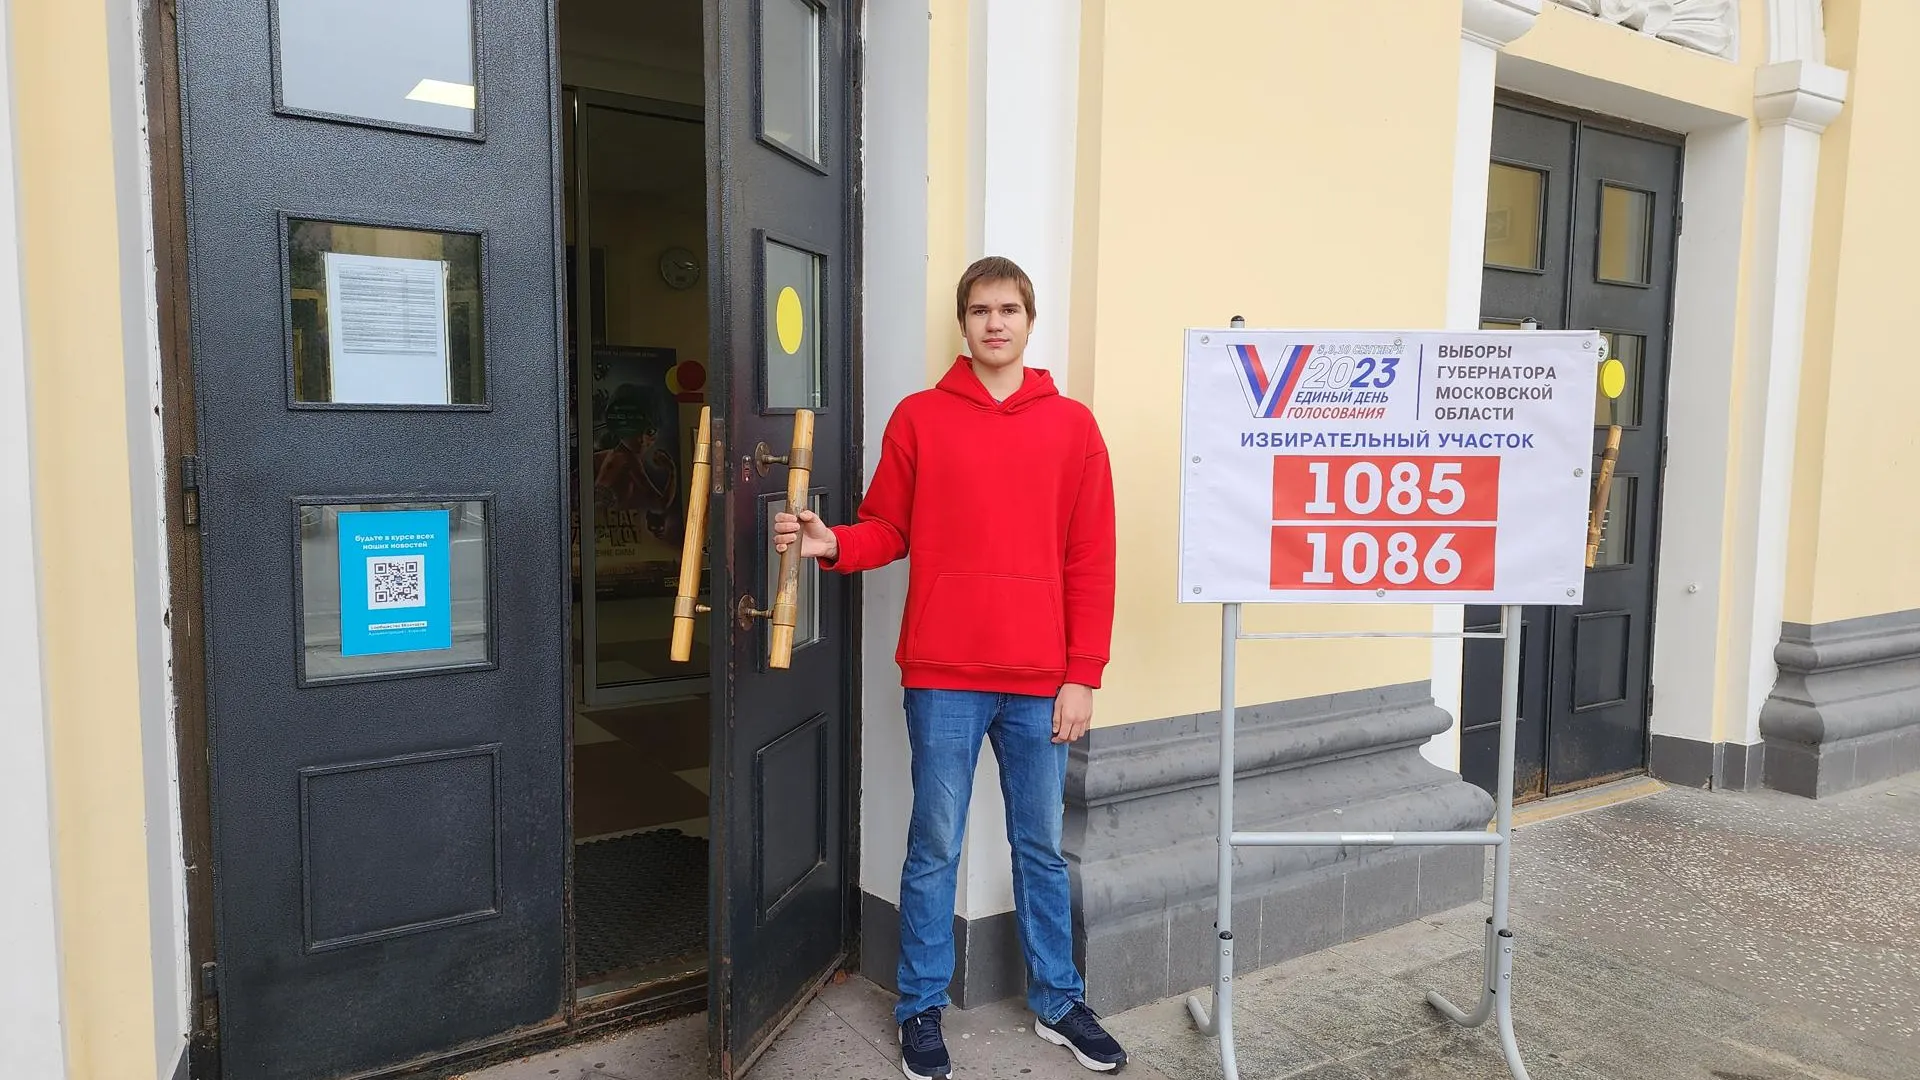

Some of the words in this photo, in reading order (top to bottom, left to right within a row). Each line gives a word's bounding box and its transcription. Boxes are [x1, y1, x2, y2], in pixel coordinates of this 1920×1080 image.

[1438, 345, 1512, 359] ВЫБОРЫ
[1302, 356, 1400, 389] 2023
[1437, 365, 1557, 380] ГУБЕРНАТОРА
[1295, 389, 1352, 405] ЕДИНЫЙ
[1354, 391, 1389, 405] ДЕНЬ
[1435, 383, 1553, 400] МОСКОВСКОЙ
[1286, 407, 1386, 419] ГОЛОСОВАНИЯ
[1434, 407, 1514, 421] ОБЛАСТИ
[1240, 429, 1430, 448] ИЗБИРАТЕЛЬНЫЙ
[1438, 433, 1534, 449] УЧАСТОК
[1304, 461, 1466, 515] 1085
[355, 534, 383, 543] будьте
[391, 534, 415, 542] курсе
[390, 541, 428, 549] новостей
[1302, 531, 1462, 585] 1086
